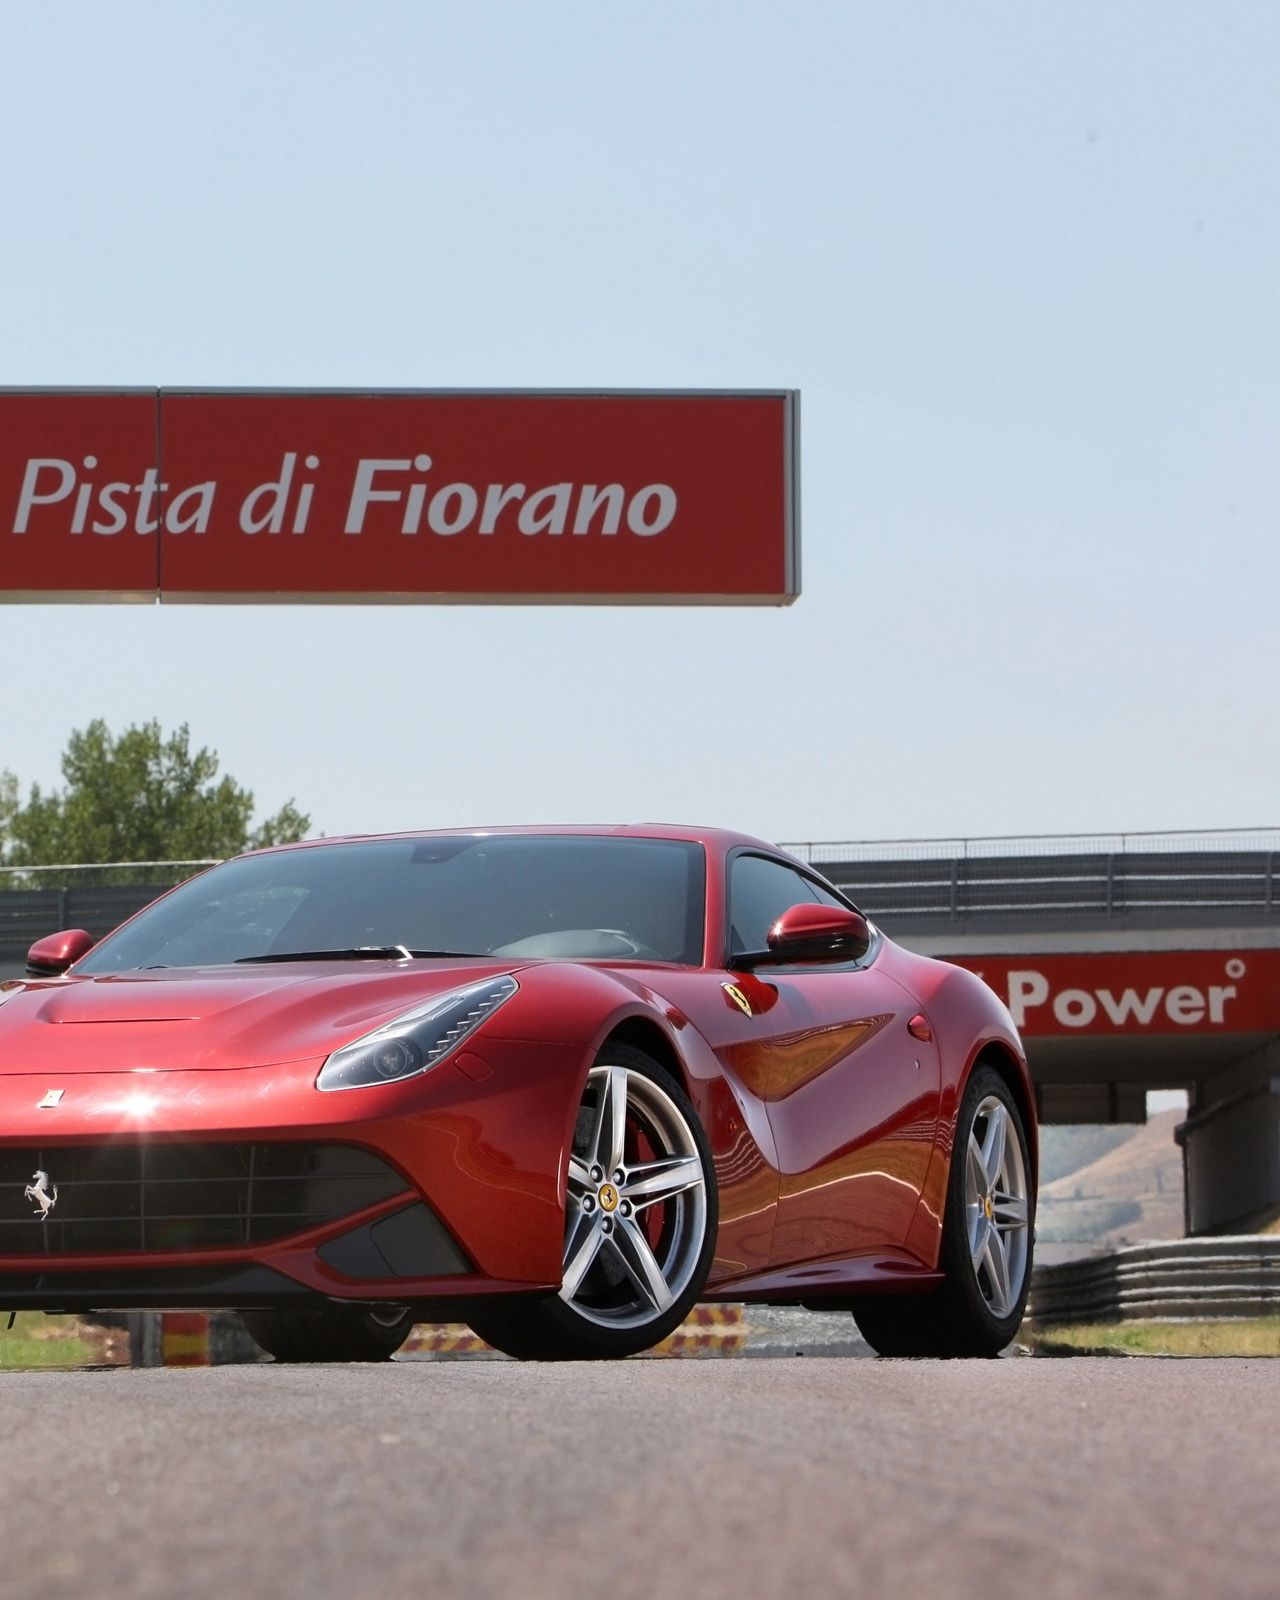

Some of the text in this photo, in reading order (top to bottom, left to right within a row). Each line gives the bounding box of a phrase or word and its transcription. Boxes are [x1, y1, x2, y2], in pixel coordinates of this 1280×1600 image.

[13, 452, 677, 536] Pista di Fiorano
[976, 969, 1237, 1028] Power
